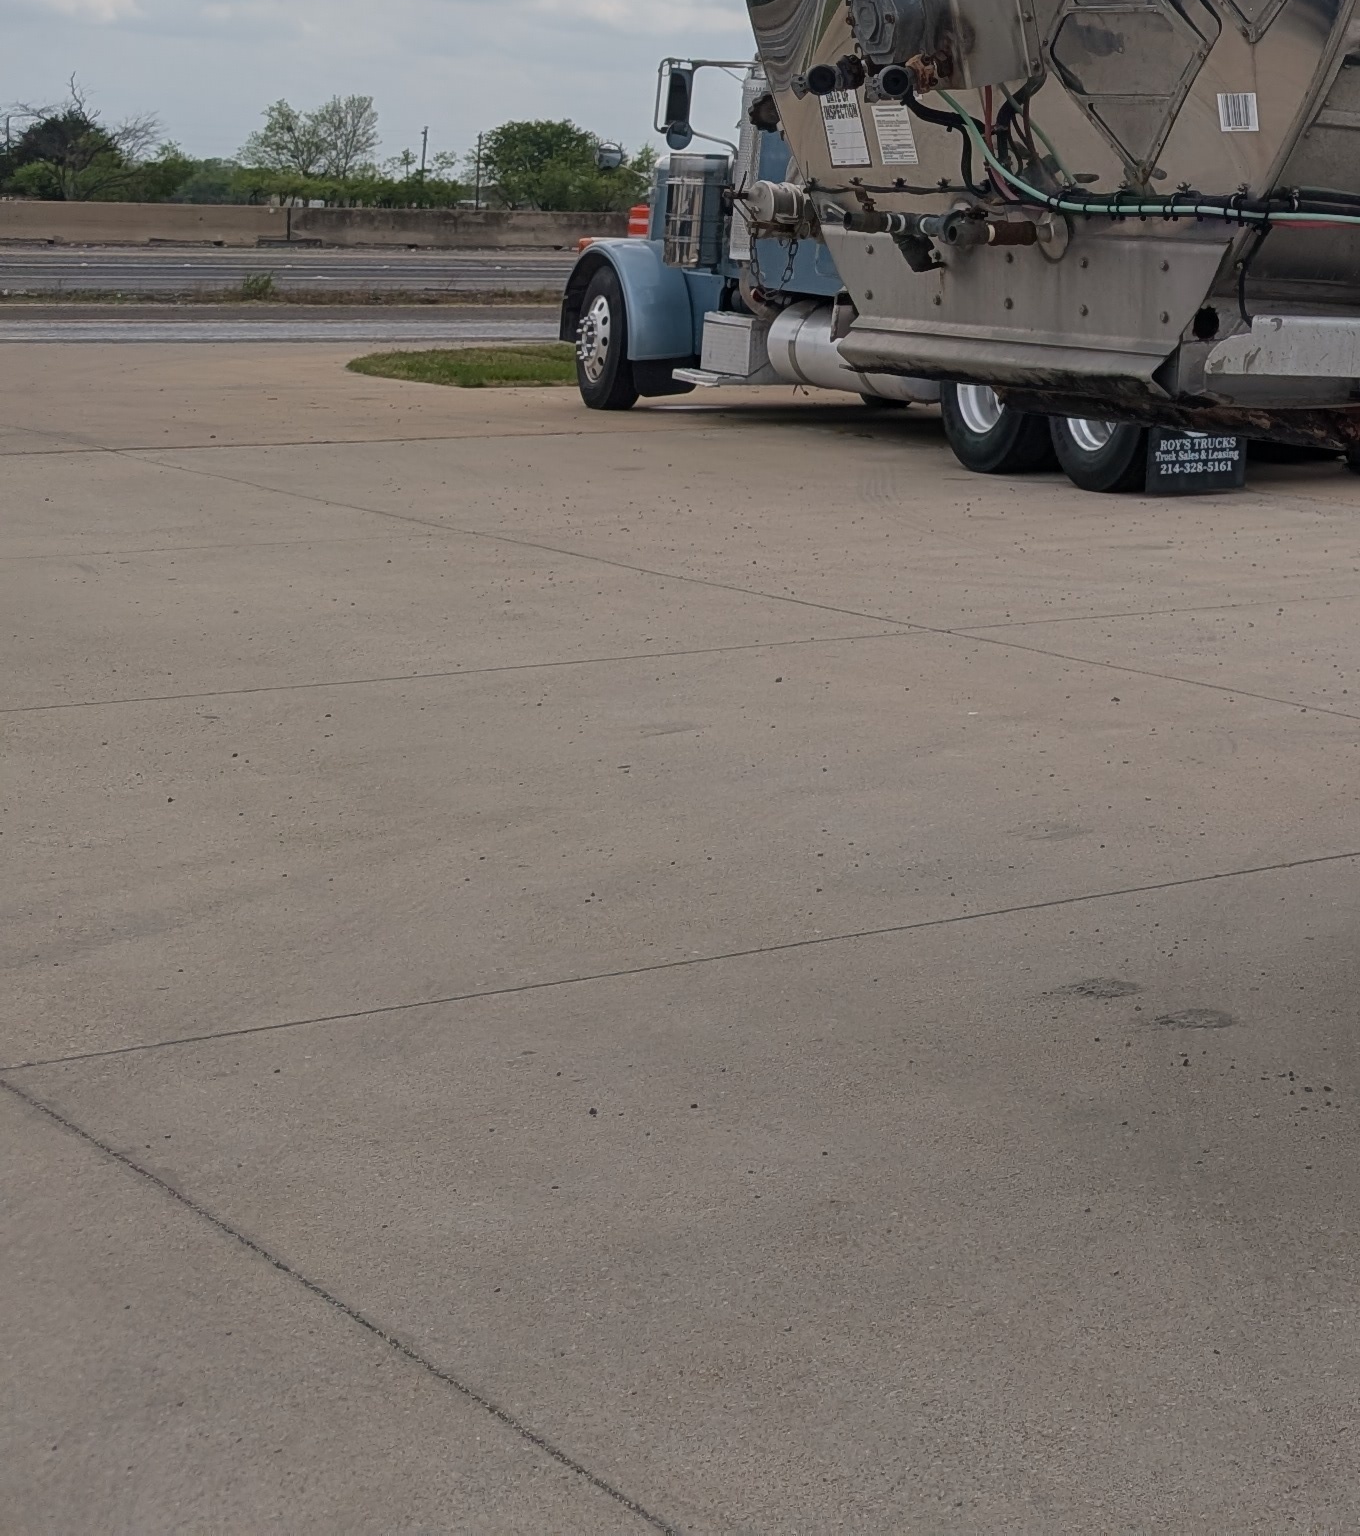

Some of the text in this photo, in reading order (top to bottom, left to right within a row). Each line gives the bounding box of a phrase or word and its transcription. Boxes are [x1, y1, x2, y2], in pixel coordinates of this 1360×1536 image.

[1160, 437, 1237, 451] ROY'S TRUCKS
[1155, 448, 1239, 462] Truck Sales & Leasing
[1160, 461, 1233, 475] 214-328-5161
